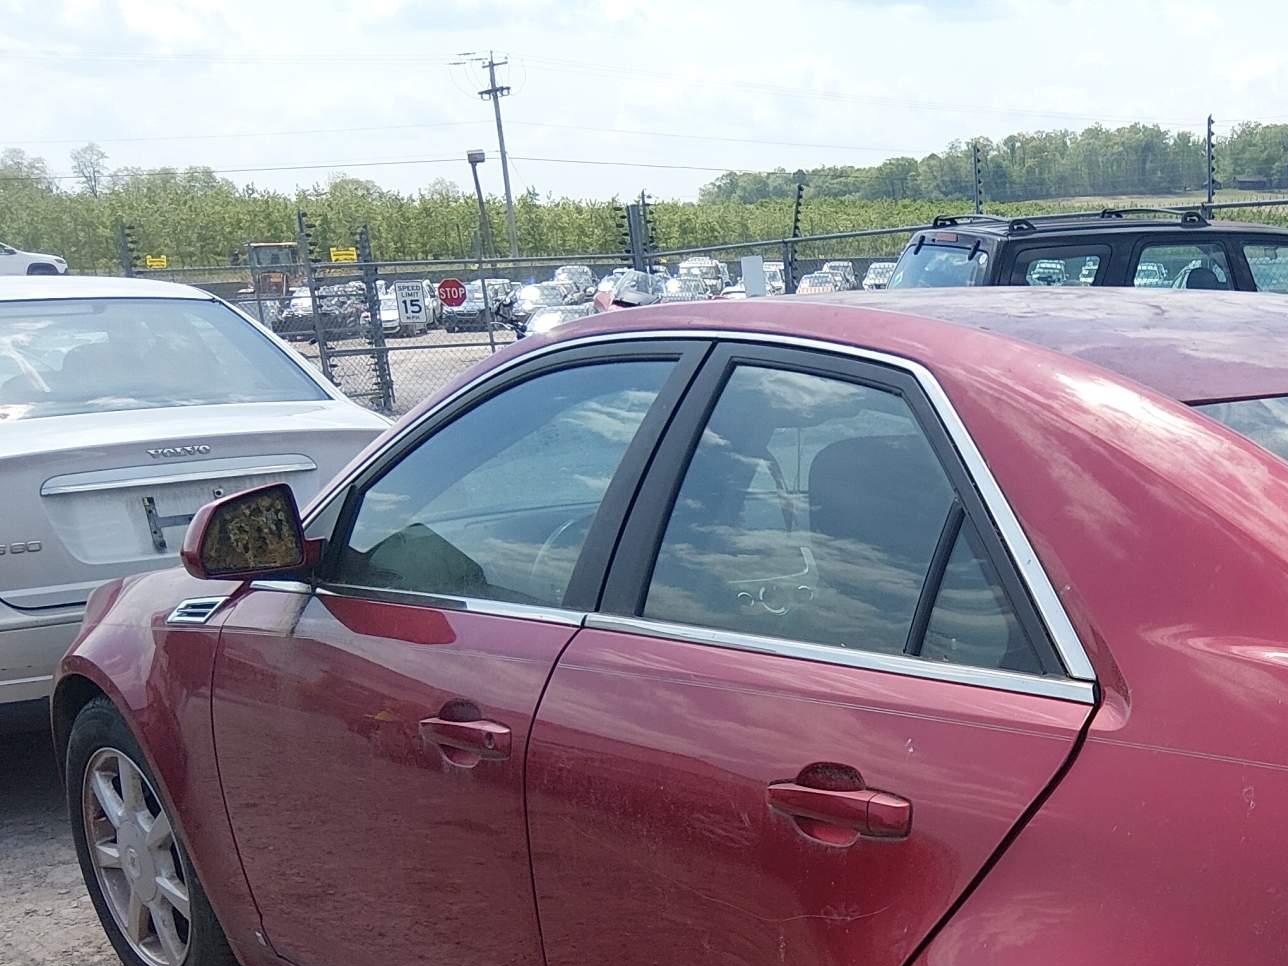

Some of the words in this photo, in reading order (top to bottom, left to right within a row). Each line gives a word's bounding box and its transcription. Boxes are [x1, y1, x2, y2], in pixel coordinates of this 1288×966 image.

[440, 287, 465, 299] STOP
[402, 299, 422, 314] 15
[145, 444, 211, 459] VOLVO
